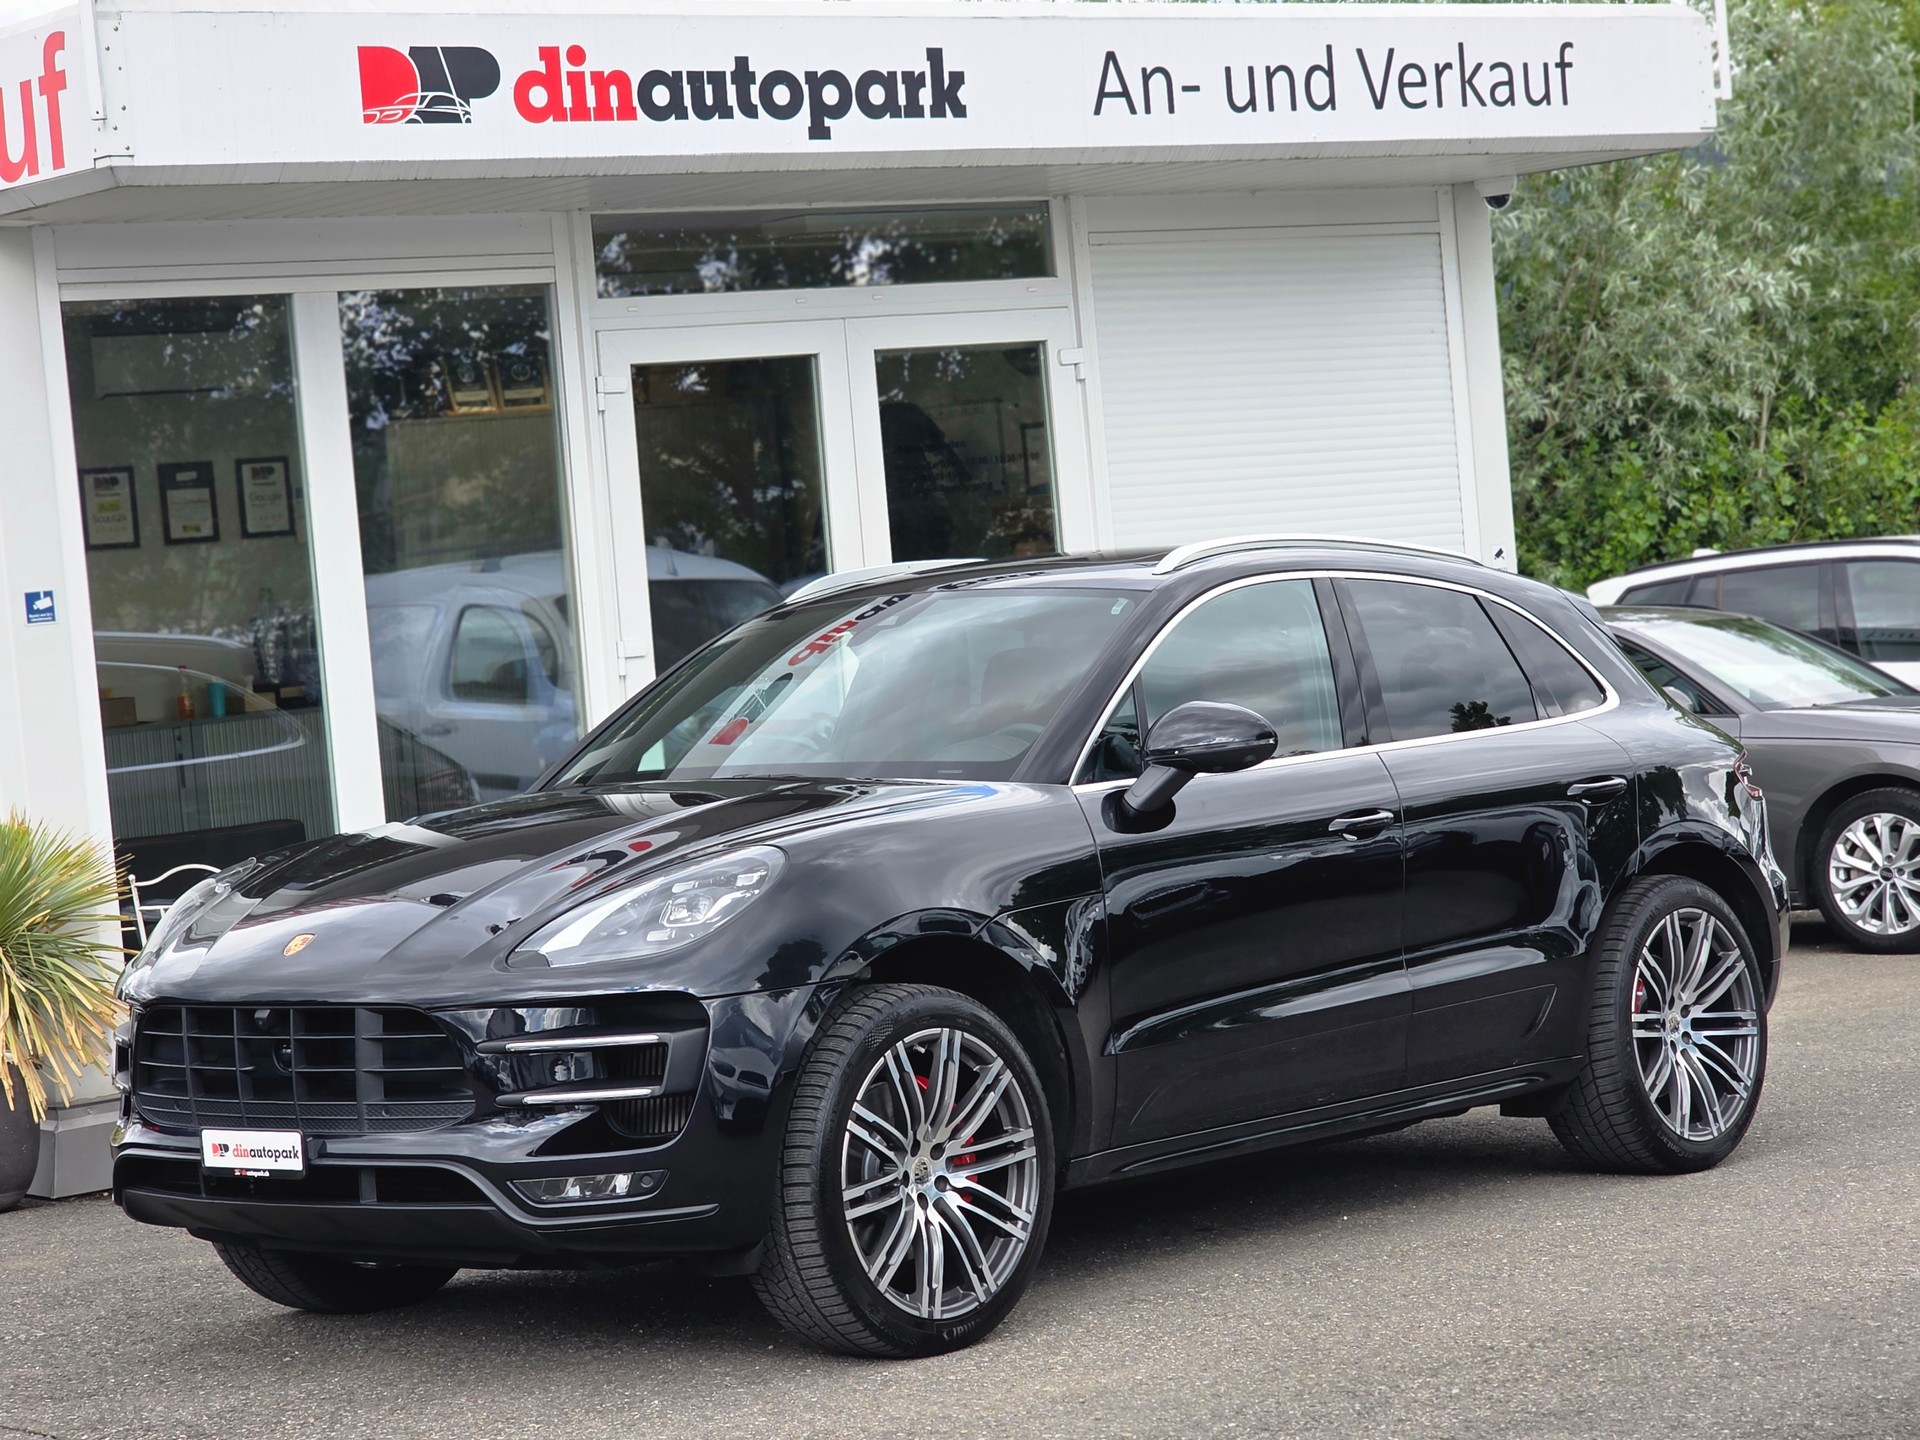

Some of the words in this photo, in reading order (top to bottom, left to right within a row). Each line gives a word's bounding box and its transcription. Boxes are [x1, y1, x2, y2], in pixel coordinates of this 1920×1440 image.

[513, 44, 967, 140] dinautopark
[1093, 51, 1200, 116] An-
[1225, 44, 1336, 113] und
[1356, 42, 1574, 110] Verkauf
[233, 1144, 299, 1163] dinautopark
